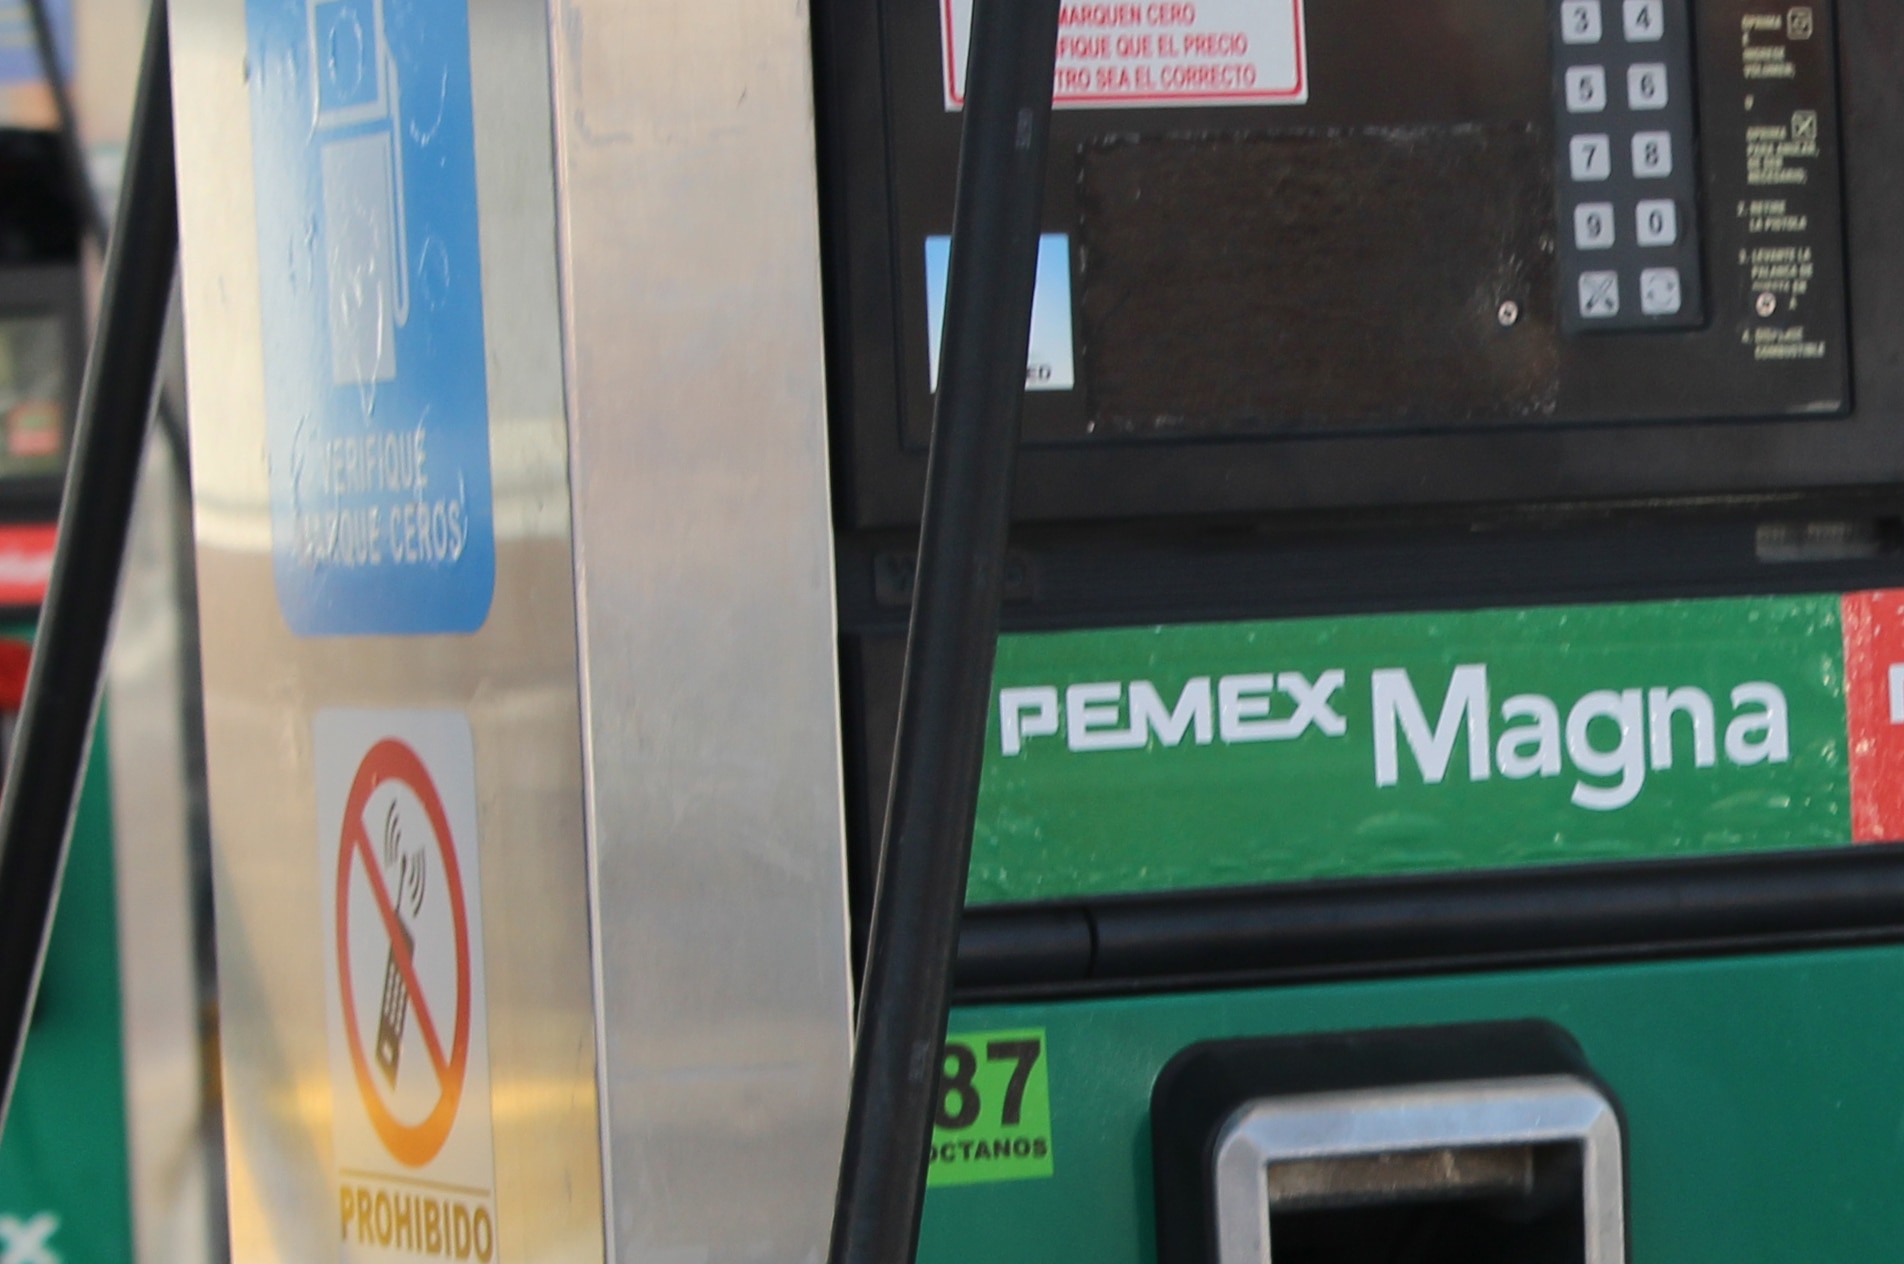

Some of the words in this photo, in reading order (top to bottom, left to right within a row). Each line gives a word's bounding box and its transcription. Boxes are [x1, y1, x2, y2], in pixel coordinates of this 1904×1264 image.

[1147, 2, 1196, 25] CERO
[1573, 8, 1589, 34] 3
[1636, 4, 1651, 29] 4
[1057, 36, 1111, 60] FIQUE
[1116, 35, 1151, 58] QUE
[1158, 34, 1179, 57] EL
[1184, 32, 1248, 57] PRECIO
[1055, 67, 1091, 91] TRO
[1096, 66, 1131, 90] SEA
[1135, 65, 1157, 88] EL
[1161, 63, 1257, 89] CORRECTO
[1578, 75, 1594, 102] 5
[1640, 73, 1656, 99] 6
[1581, 144, 1598, 170] 7
[1644, 141, 1660, 167] 8
[1586, 213, 1602, 240] 9
[1026, 363, 1052, 384] ED
[391, 500, 464, 564] CEROS
[999, 668, 1347, 756] PEMEX
[1371, 663, 1790, 811] Magna
[934, 1038, 1041, 1131] 87
